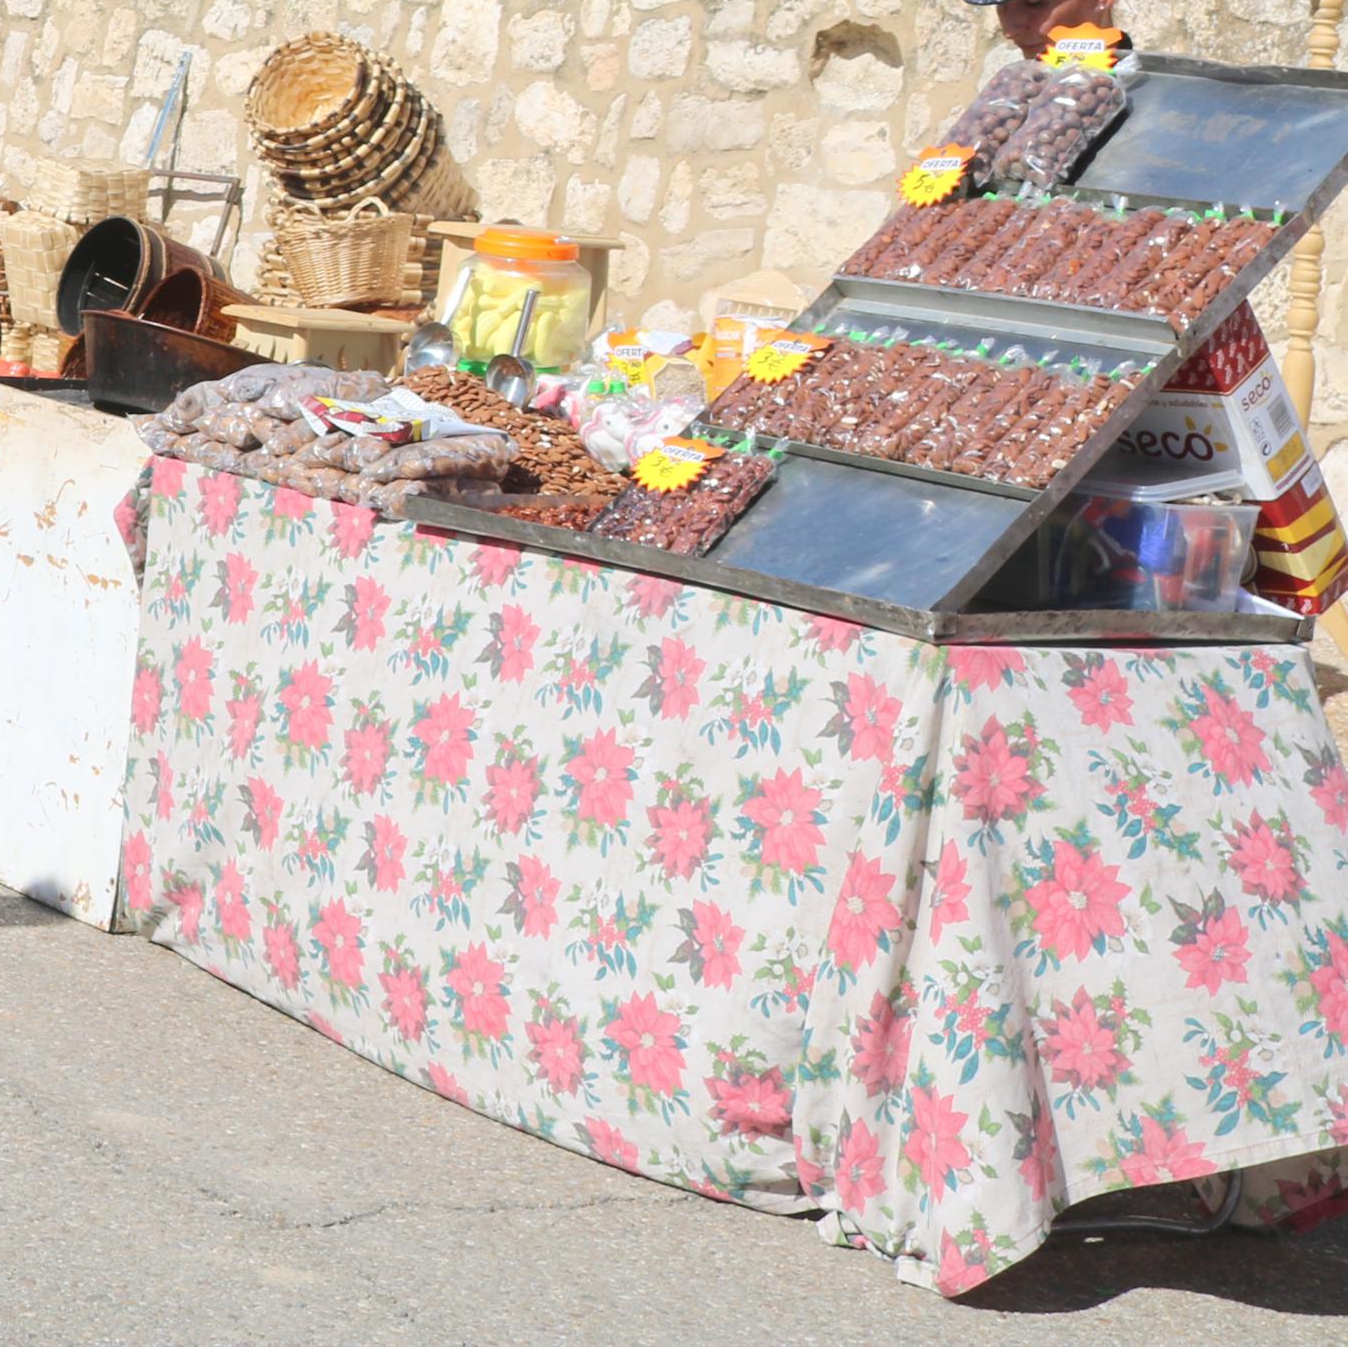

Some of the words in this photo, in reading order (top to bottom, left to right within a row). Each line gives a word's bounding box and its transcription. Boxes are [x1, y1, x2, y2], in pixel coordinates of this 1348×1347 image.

[1057, 41, 1102, 51] OFERTA
[922, 159, 960, 169] OFERTA
[615, 347, 643, 357] OFERT
[774, 340, 809, 353] OFERTA
[1240, 375, 1272, 412] seco
[1117, 429, 1214, 462] seco
[663, 446, 703, 461] OFERTA
